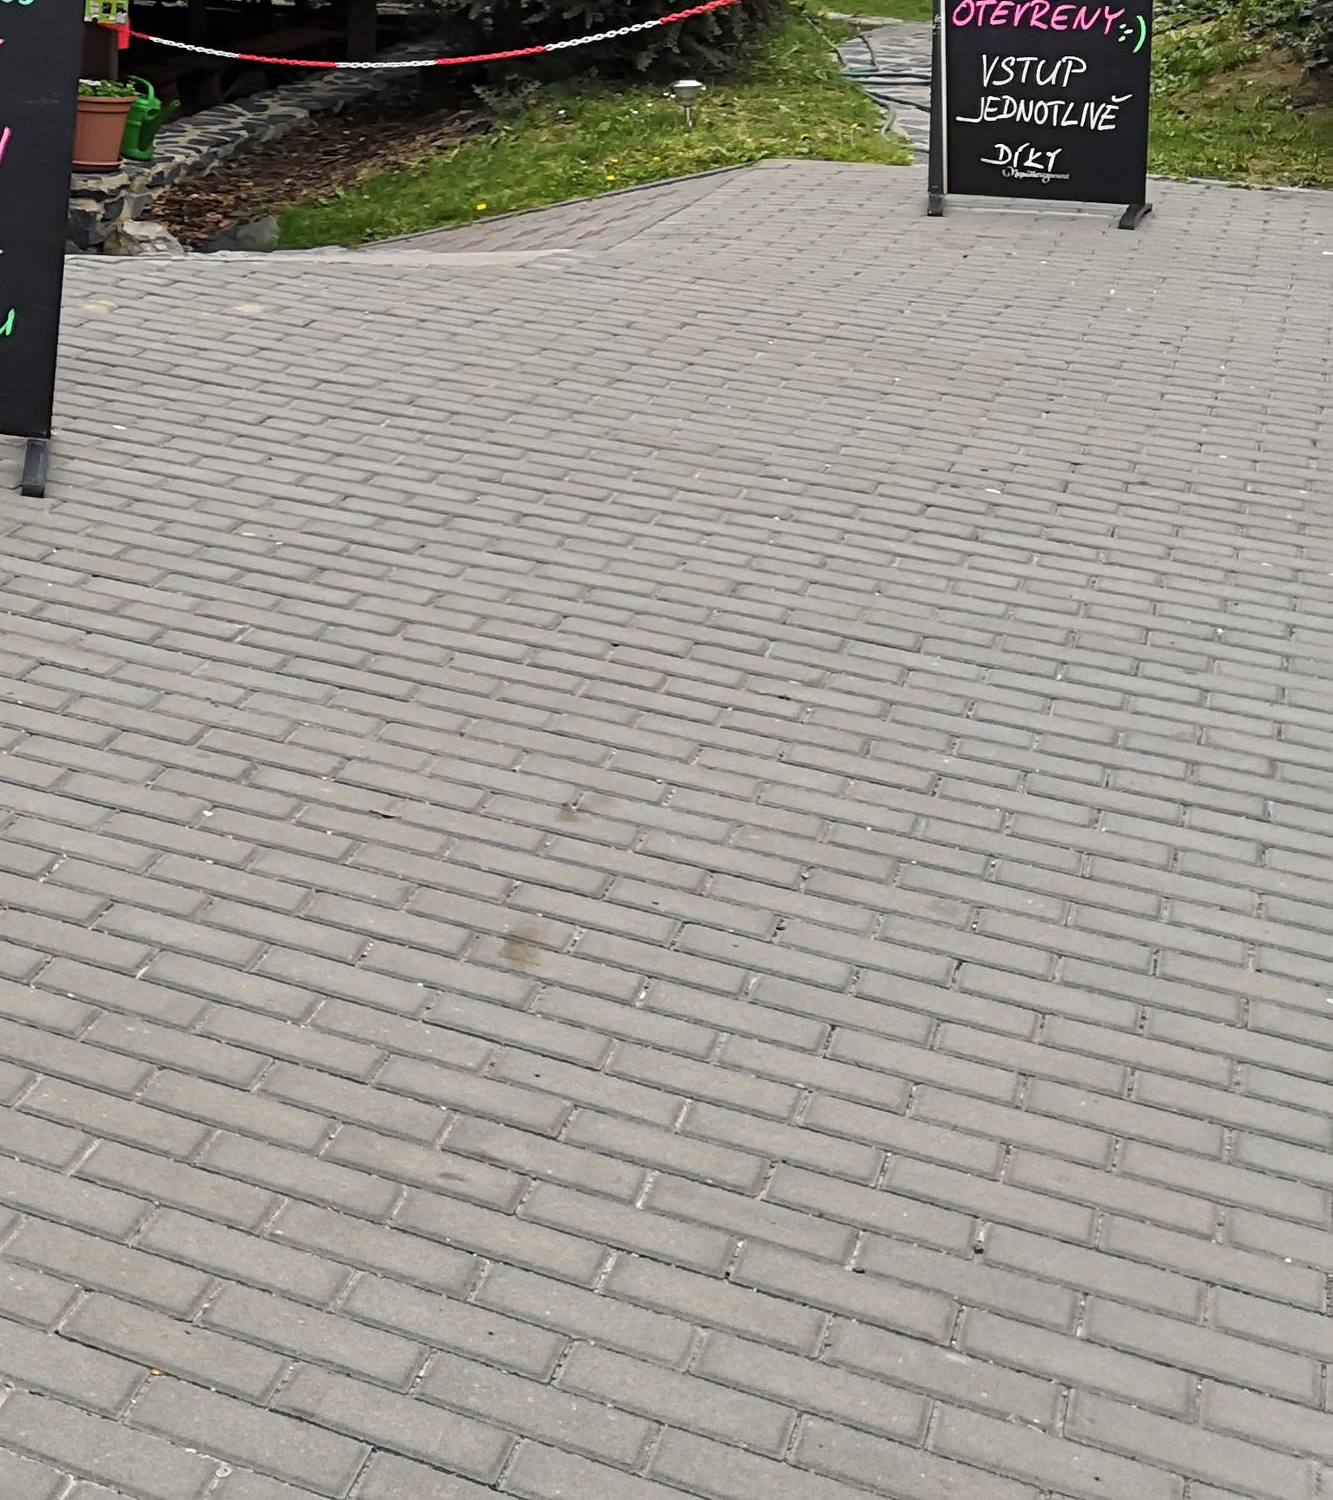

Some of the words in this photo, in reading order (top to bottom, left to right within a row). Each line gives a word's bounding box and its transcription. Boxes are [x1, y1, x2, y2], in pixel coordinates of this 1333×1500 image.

[981, 54, 1088, 88] VSTUP
[955, 93, 1133, 132] JEDNOTLIVĚ
[980, 142, 1063, 173] DÍKY
